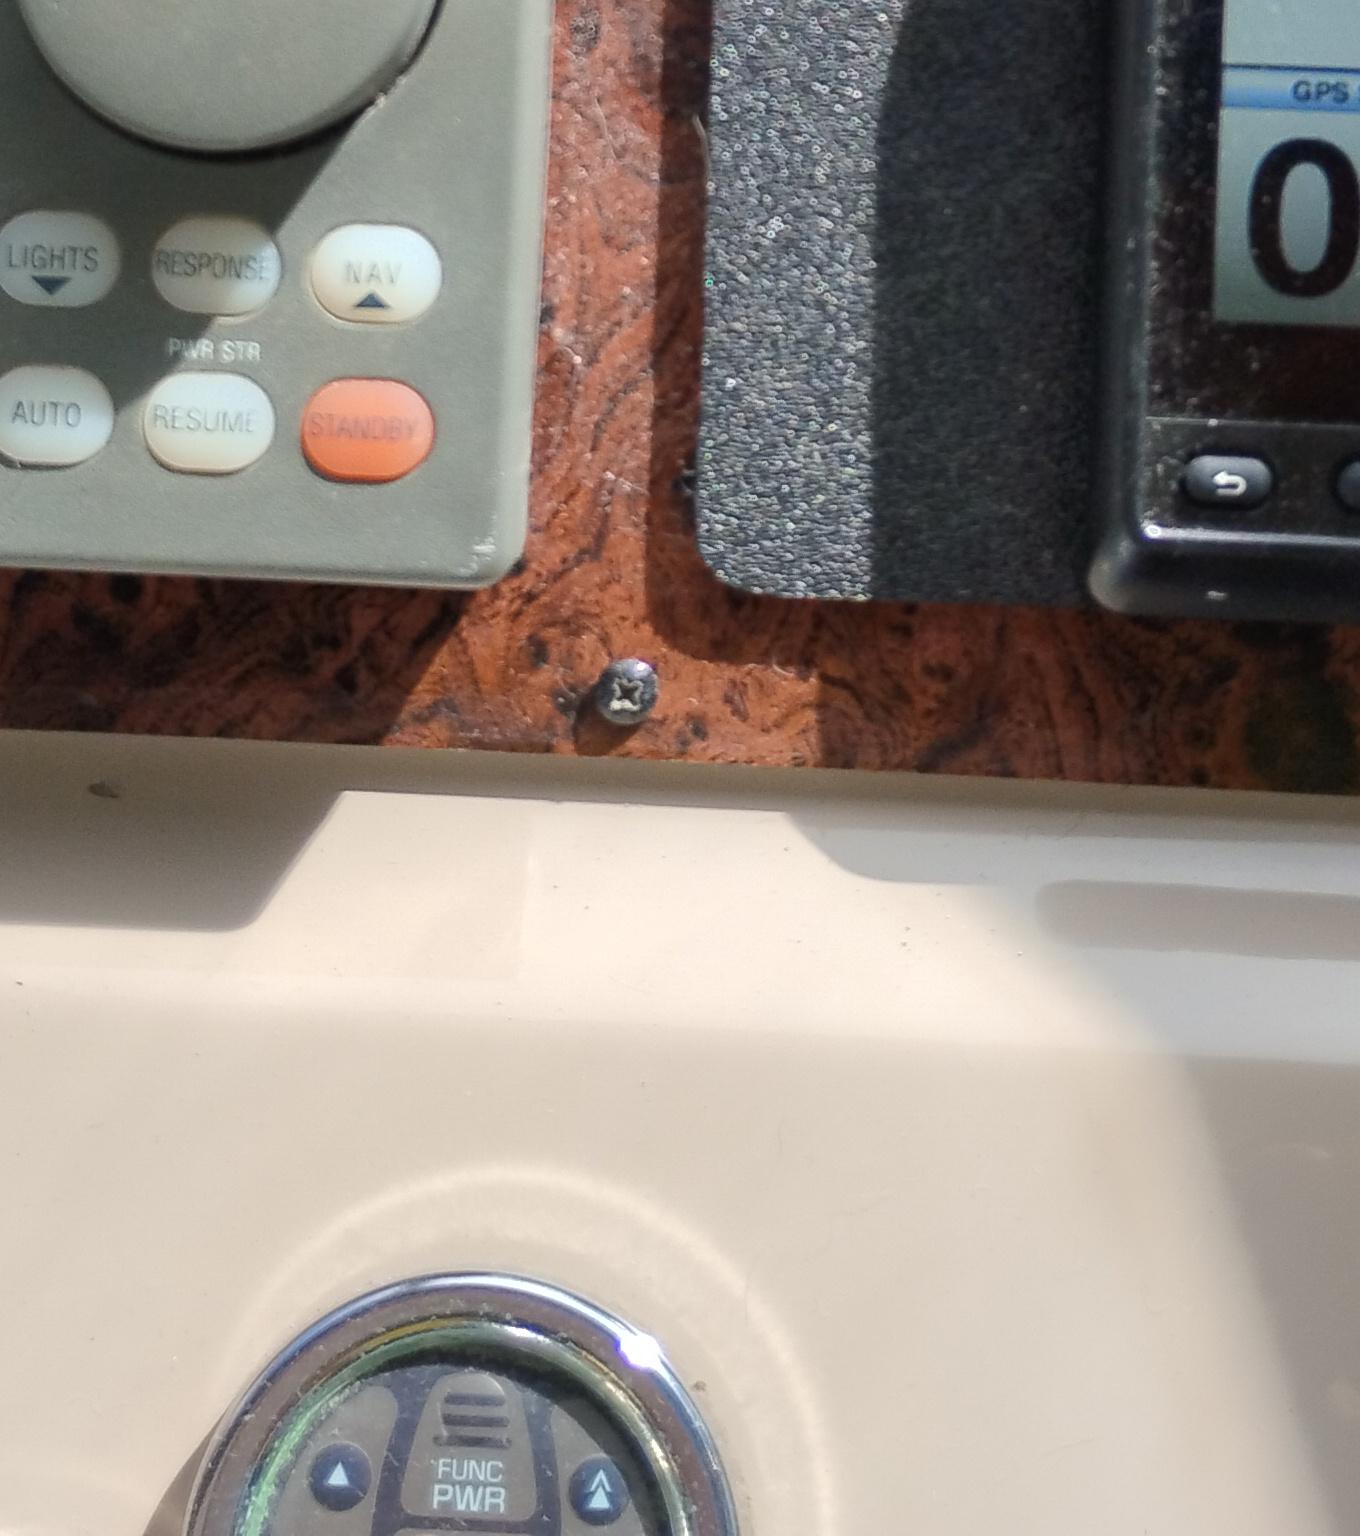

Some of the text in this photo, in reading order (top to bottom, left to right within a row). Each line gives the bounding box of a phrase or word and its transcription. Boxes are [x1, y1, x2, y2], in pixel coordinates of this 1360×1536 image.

[1293, 81, 1350, 105] GPS
[8, 244, 99, 272] LIGHTS
[157, 250, 268, 281] RESPONSE
[345, 262, 402, 284] NAV
[168, 337, 261, 363] PWR STR
[12, 401, 82, 428] AUTO
[153, 405, 255, 433] RESUME
[310, 413, 416, 439] STANDBY
[438, 1458, 502, 1482] FUNC
[433, 1485, 506, 1513] PWR
